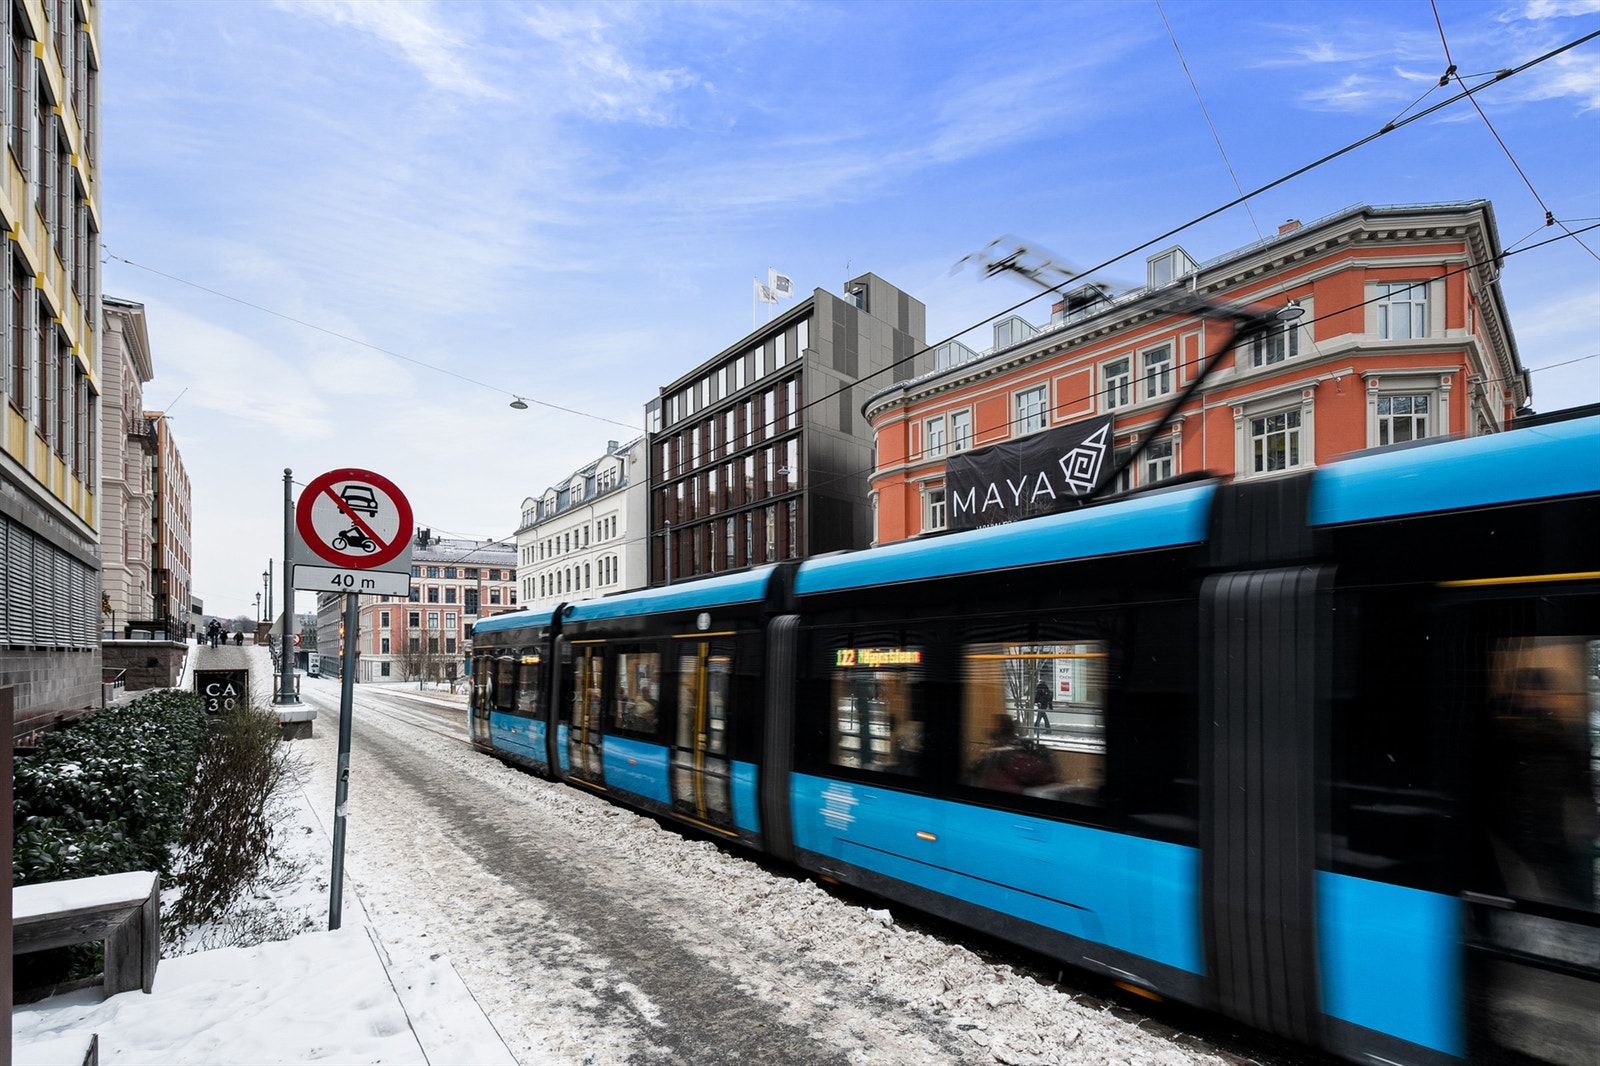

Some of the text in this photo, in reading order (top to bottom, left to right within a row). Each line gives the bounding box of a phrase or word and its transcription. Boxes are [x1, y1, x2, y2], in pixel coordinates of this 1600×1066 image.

[953, 471, 1057, 517] MAYA
[331, 574, 375, 589] 40 m
[206, 683, 237, 697] CA
[208, 698, 236, 711] 30
